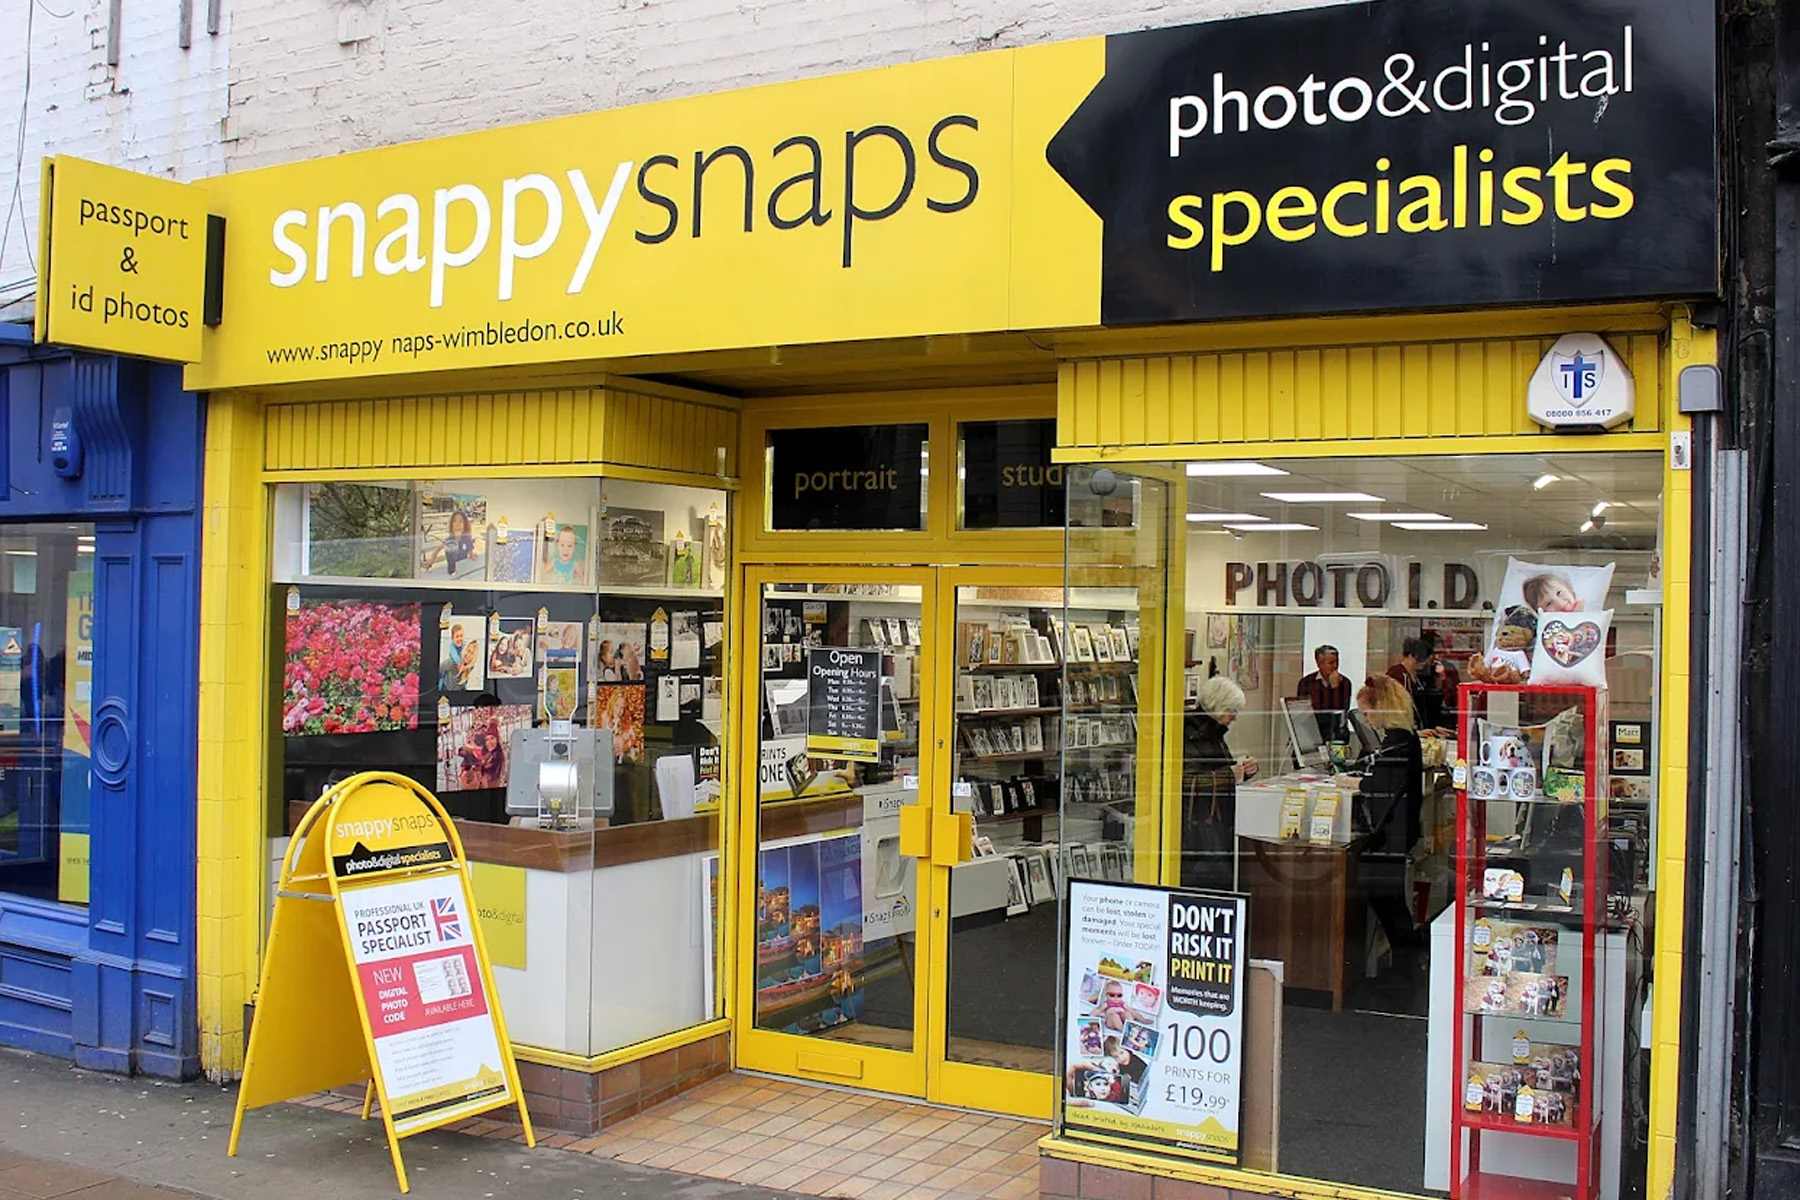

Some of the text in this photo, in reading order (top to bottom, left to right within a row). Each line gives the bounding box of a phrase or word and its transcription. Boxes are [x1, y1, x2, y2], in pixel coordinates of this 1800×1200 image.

[1169, 25, 1634, 158] photo&digital
[80, 198, 189, 240] passport
[1167, 144, 1635, 272] specialists
[120, 246, 139, 275] &
[71, 284, 190, 329] id photos
[795, 463, 899, 501] portrait
[1225, 561, 1494, 610] PHOTO I.D.
[829, 650, 863, 667] Open
[812, 665, 877, 680] Opening Hours
[354, 902, 413, 919] PROFESSIONAL
[1100, 896, 1123, 905] phone
[357, 912, 428, 938] PASSPORT
[1123, 910, 1147, 918] stolen
[1172, 903, 1234, 934] DON'T
[361, 930, 432, 955] SPECIALIST
[1171, 932, 1233, 960] RISK IT
[372, 965, 403, 986] NEW
[1171, 958, 1232, 984] PRINT IT
[378, 986, 409, 1000] DIGITAL
[381, 999, 409, 1013] PHOTO
[383, 1011, 406, 1024] CODE
[424, 998, 475, 1017] AVAILABLE HERE
[1167, 1022, 1231, 1063] 100
[1165, 1065, 1231, 1085] PRINTS FOR
